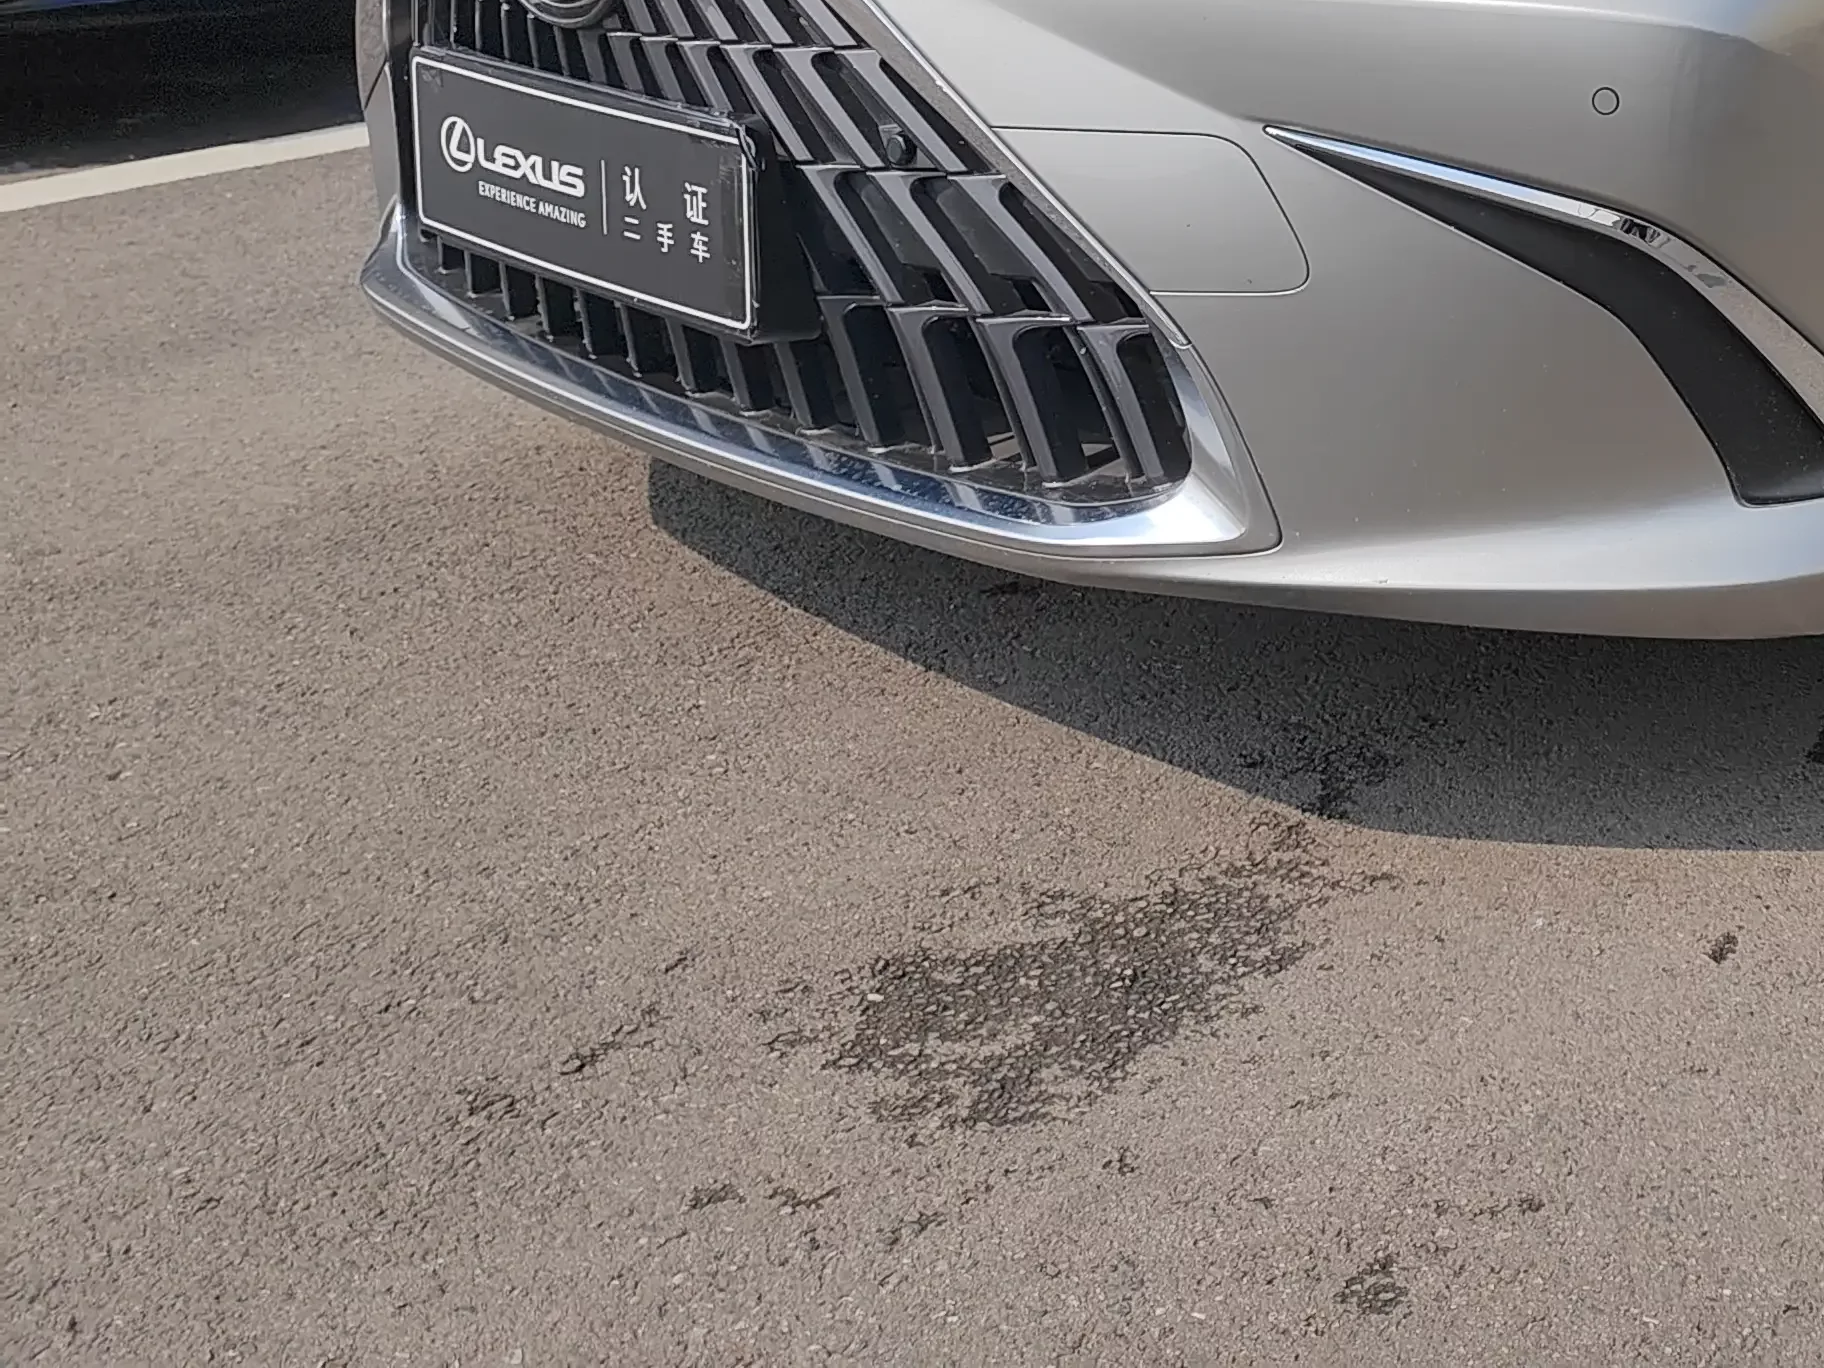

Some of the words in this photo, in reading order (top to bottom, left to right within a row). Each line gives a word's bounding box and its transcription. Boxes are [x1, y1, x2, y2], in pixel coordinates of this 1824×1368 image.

[476, 137, 585, 198] LEXUS
[478, 180, 537, 213] EXPERIENCE
[538, 201, 587, 228] AMAZING
[624, 216, 711, 263] 二手车
